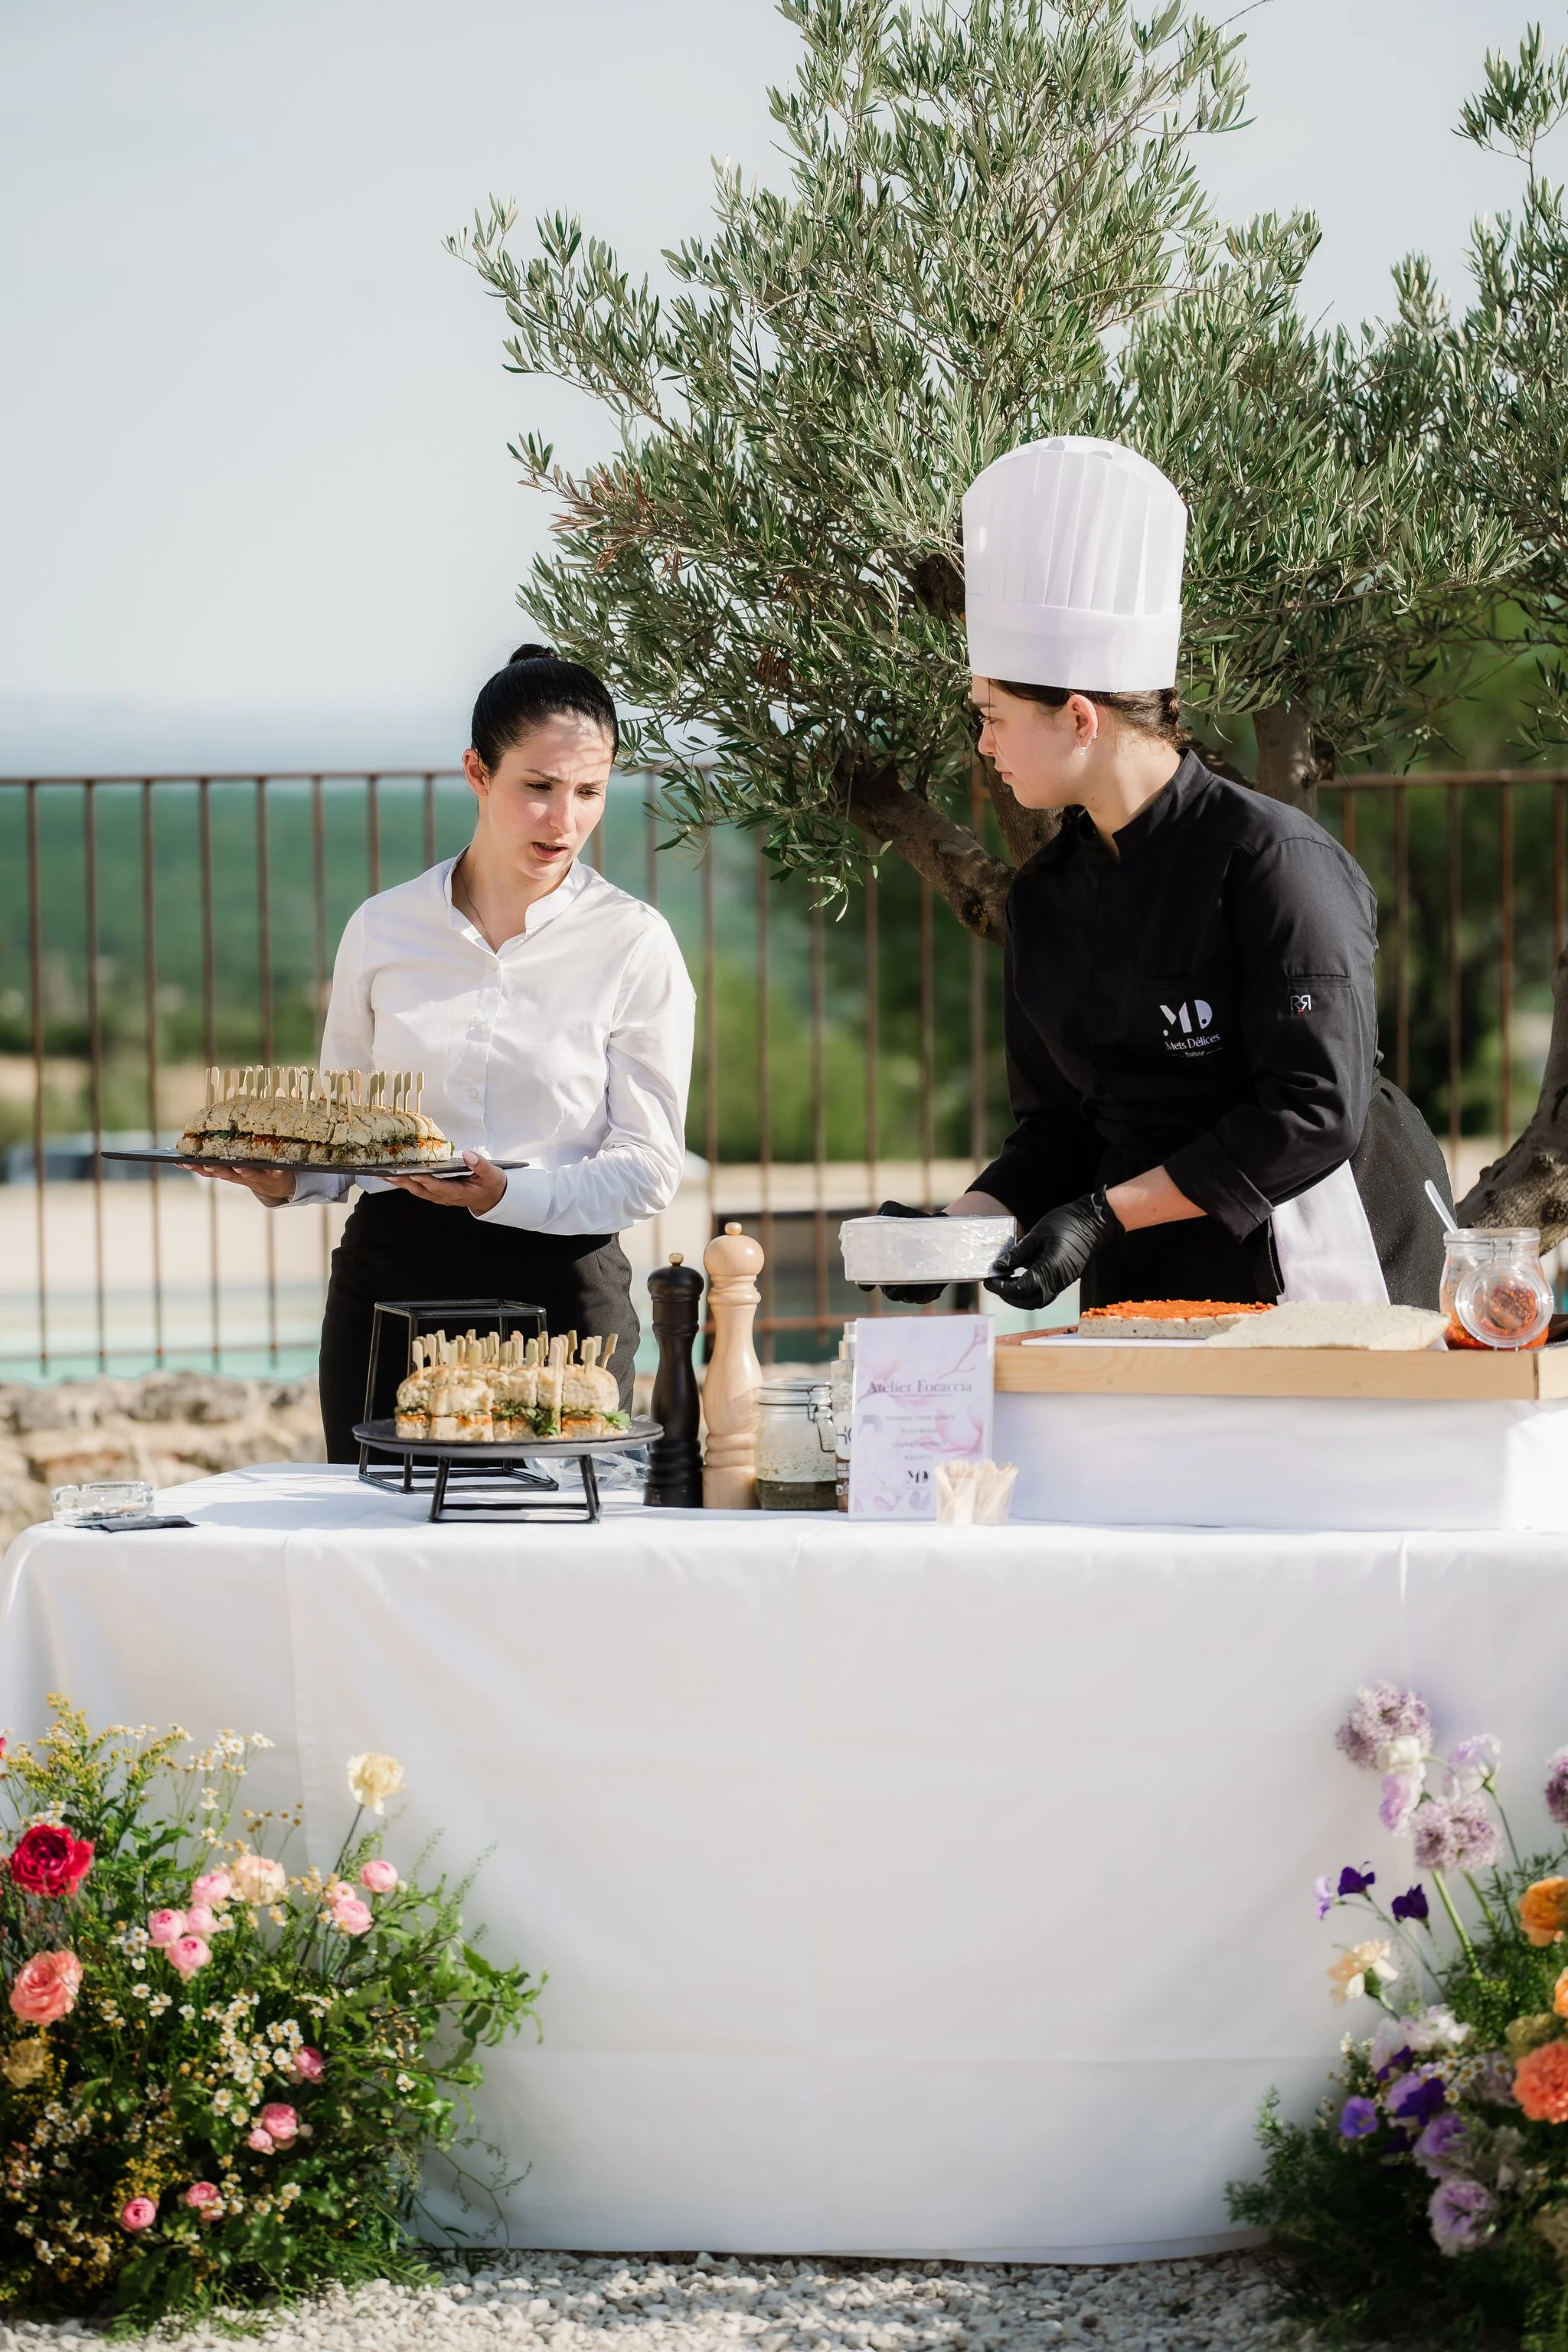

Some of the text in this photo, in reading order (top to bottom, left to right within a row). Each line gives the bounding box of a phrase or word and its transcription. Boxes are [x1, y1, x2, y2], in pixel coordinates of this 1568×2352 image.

[1165, 1034, 1220, 1050] Mets Délices
[867, 1380, 972, 1393] Atelier Focaccia
